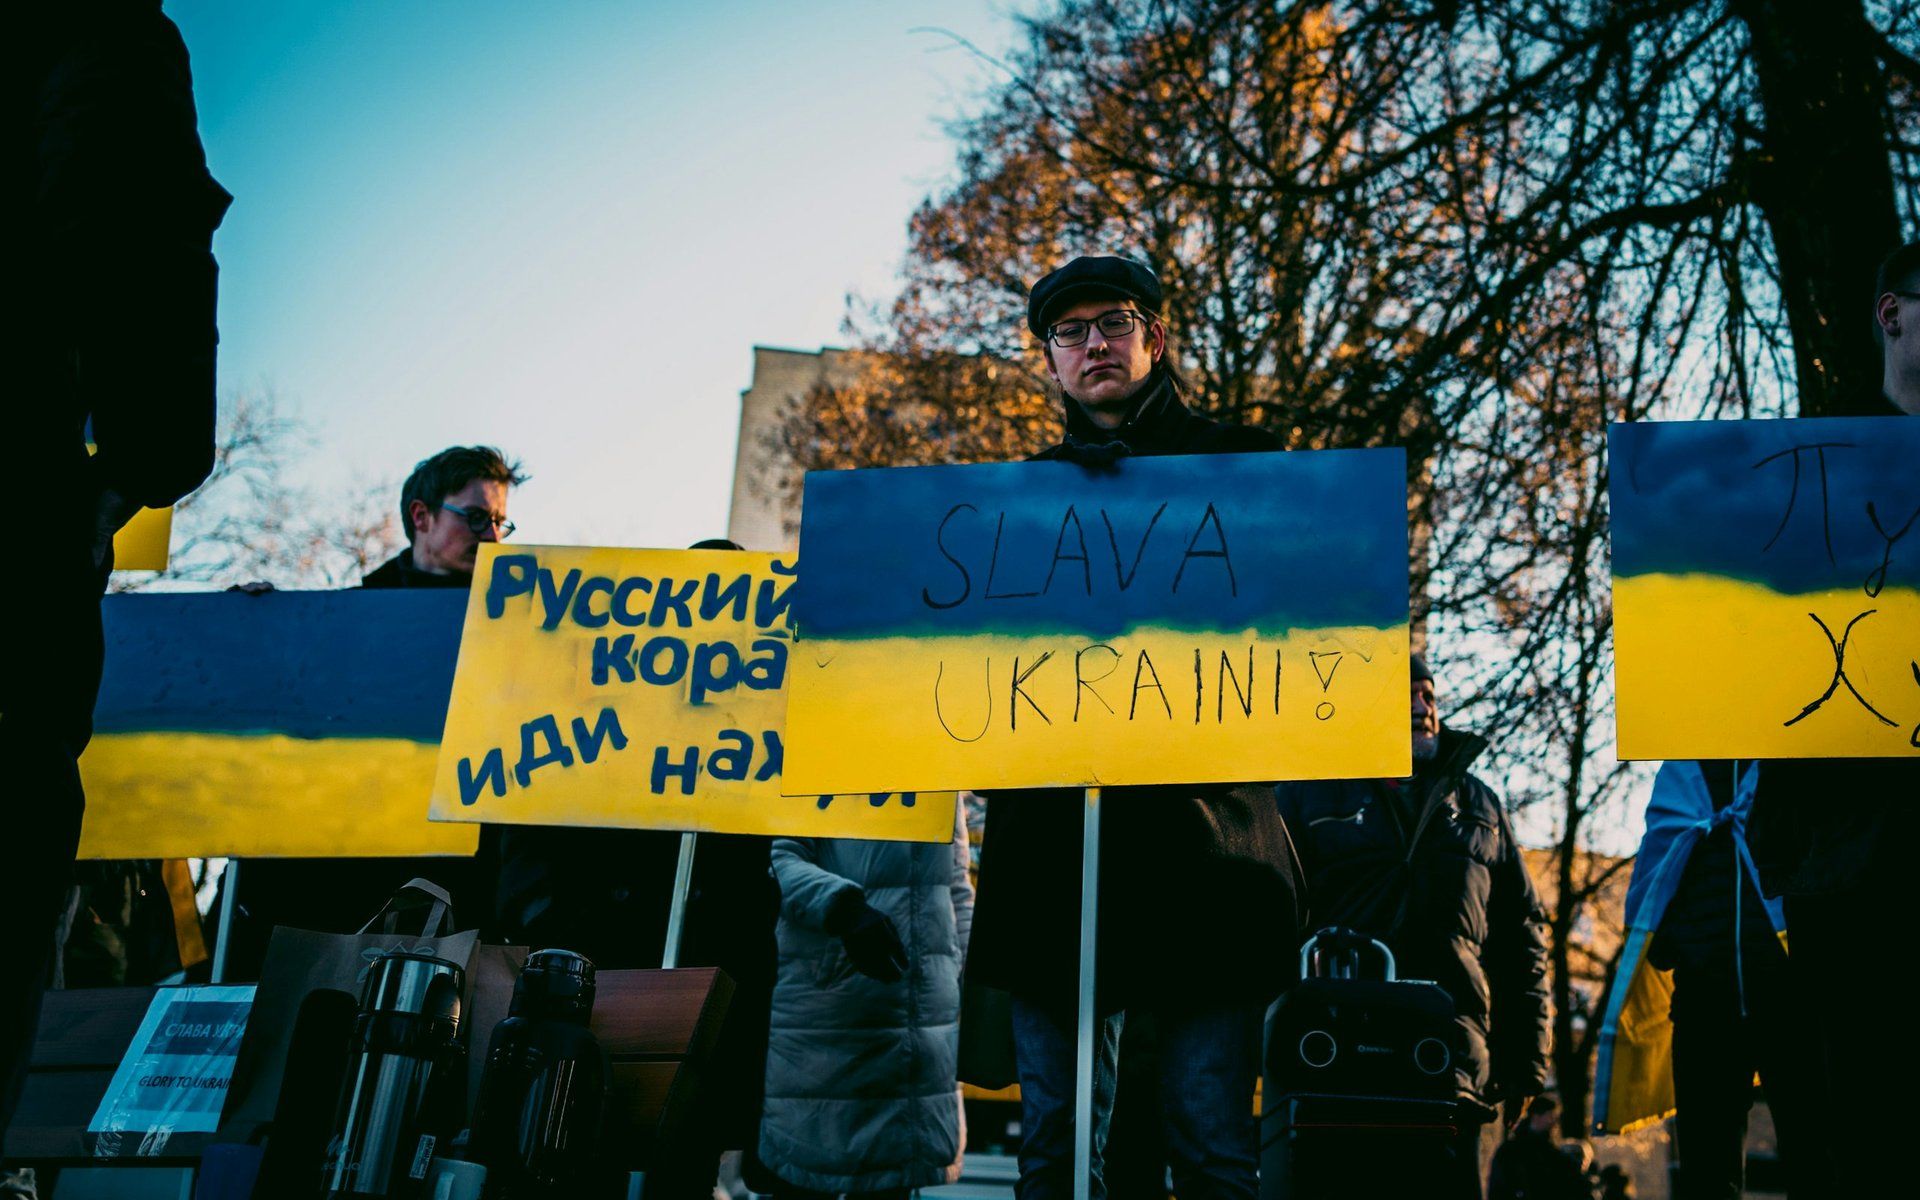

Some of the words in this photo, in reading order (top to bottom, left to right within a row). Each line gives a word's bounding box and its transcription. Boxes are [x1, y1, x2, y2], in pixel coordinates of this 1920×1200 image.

[486, 554, 798, 631] Русский
[922, 501, 1237, 610] SLAVA
[590, 633, 789, 705] кора
[934, 643, 1344, 743] UKRAINI!
[1783, 608, 1920, 749] Х
[456, 707, 628, 806] иди
[165, 1023, 212, 1038] СЛАВА
[139, 1075, 177, 1088] GLORY
[176, 1076, 192, 1088] TO
